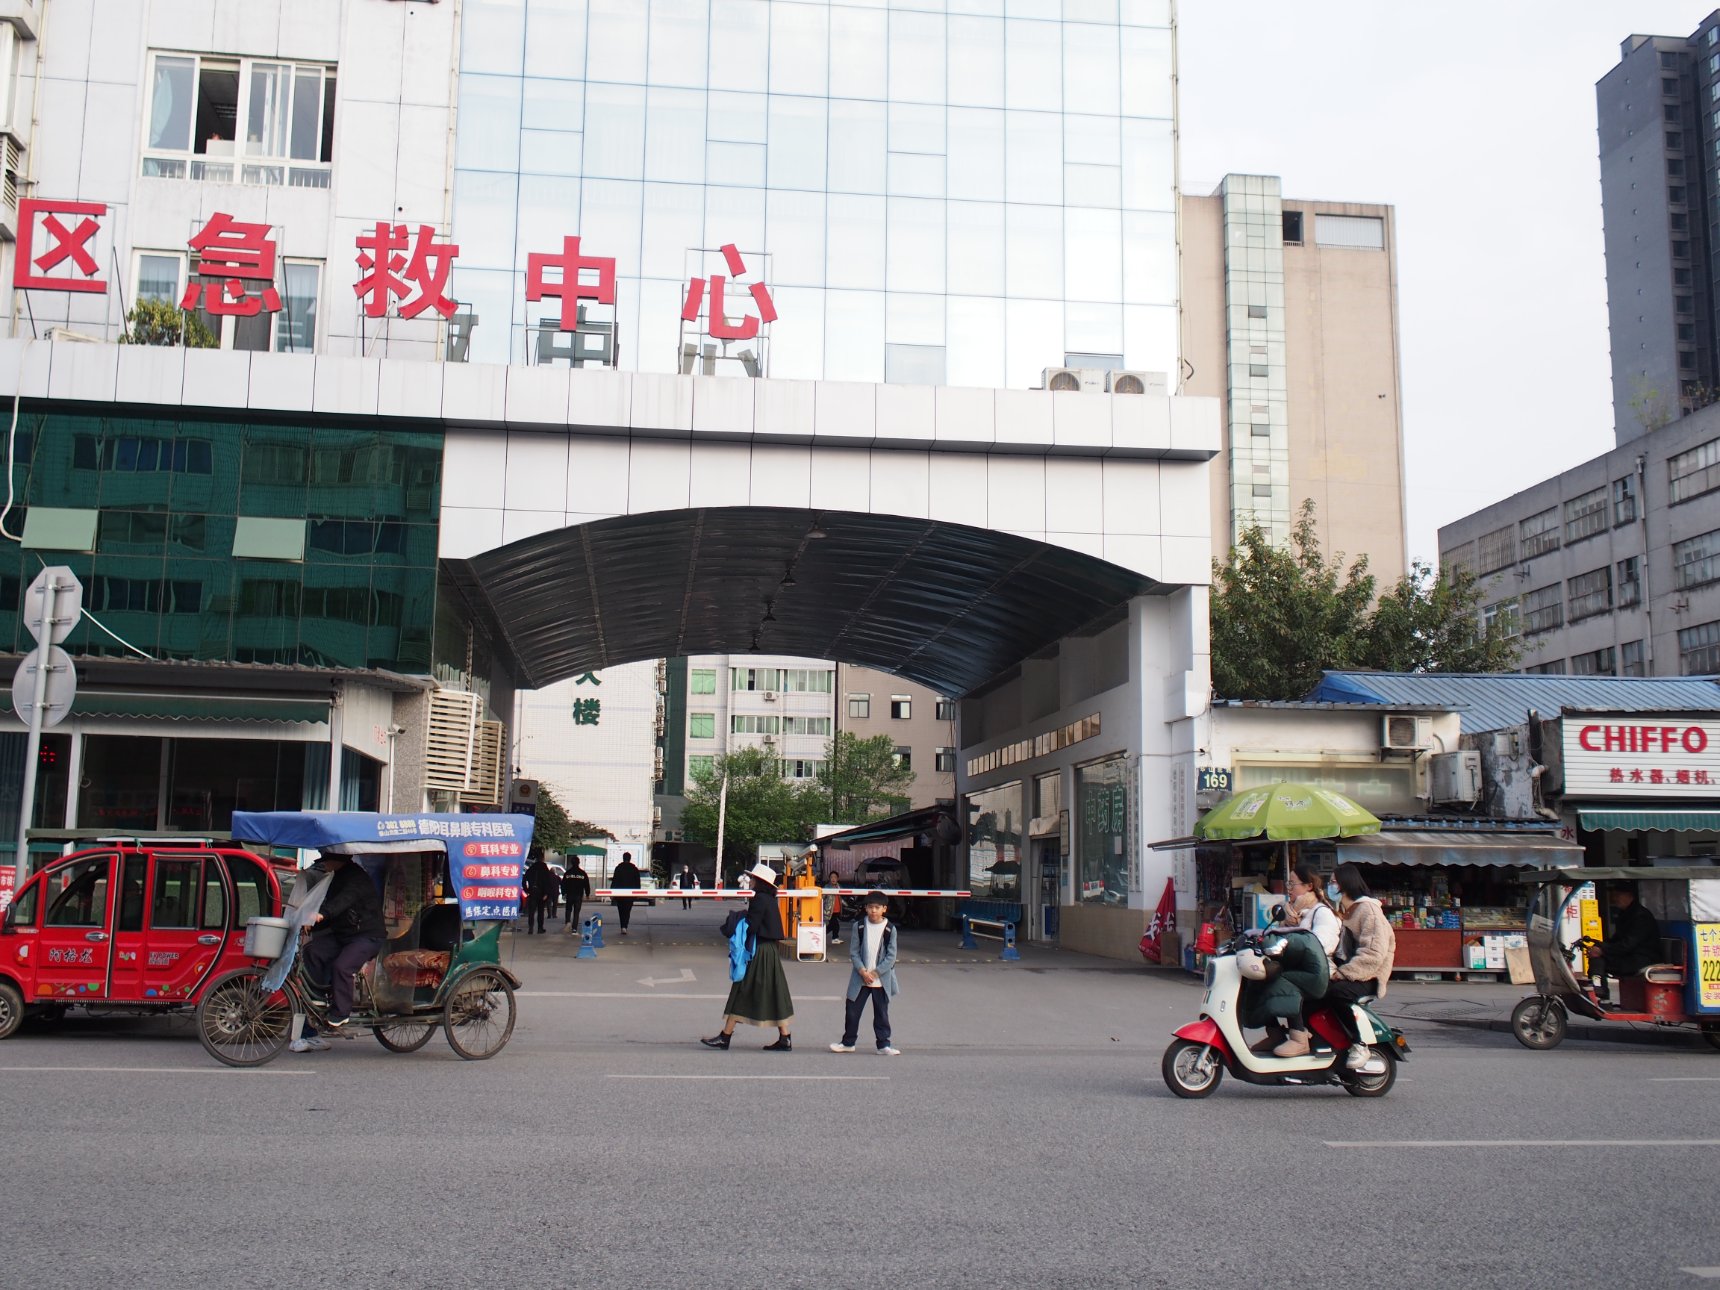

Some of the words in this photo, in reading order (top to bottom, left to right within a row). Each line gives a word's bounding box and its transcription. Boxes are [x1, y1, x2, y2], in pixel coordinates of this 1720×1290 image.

[13, 198, 777, 341] 区急救中心
[1579, 725, 1708, 753] CHIFFO
[1203, 774, 1227, 788] 169
[418, 819, 515, 838] 德阳耳鼻喉专科医院
[480, 843, 519, 856] 耳科专业
